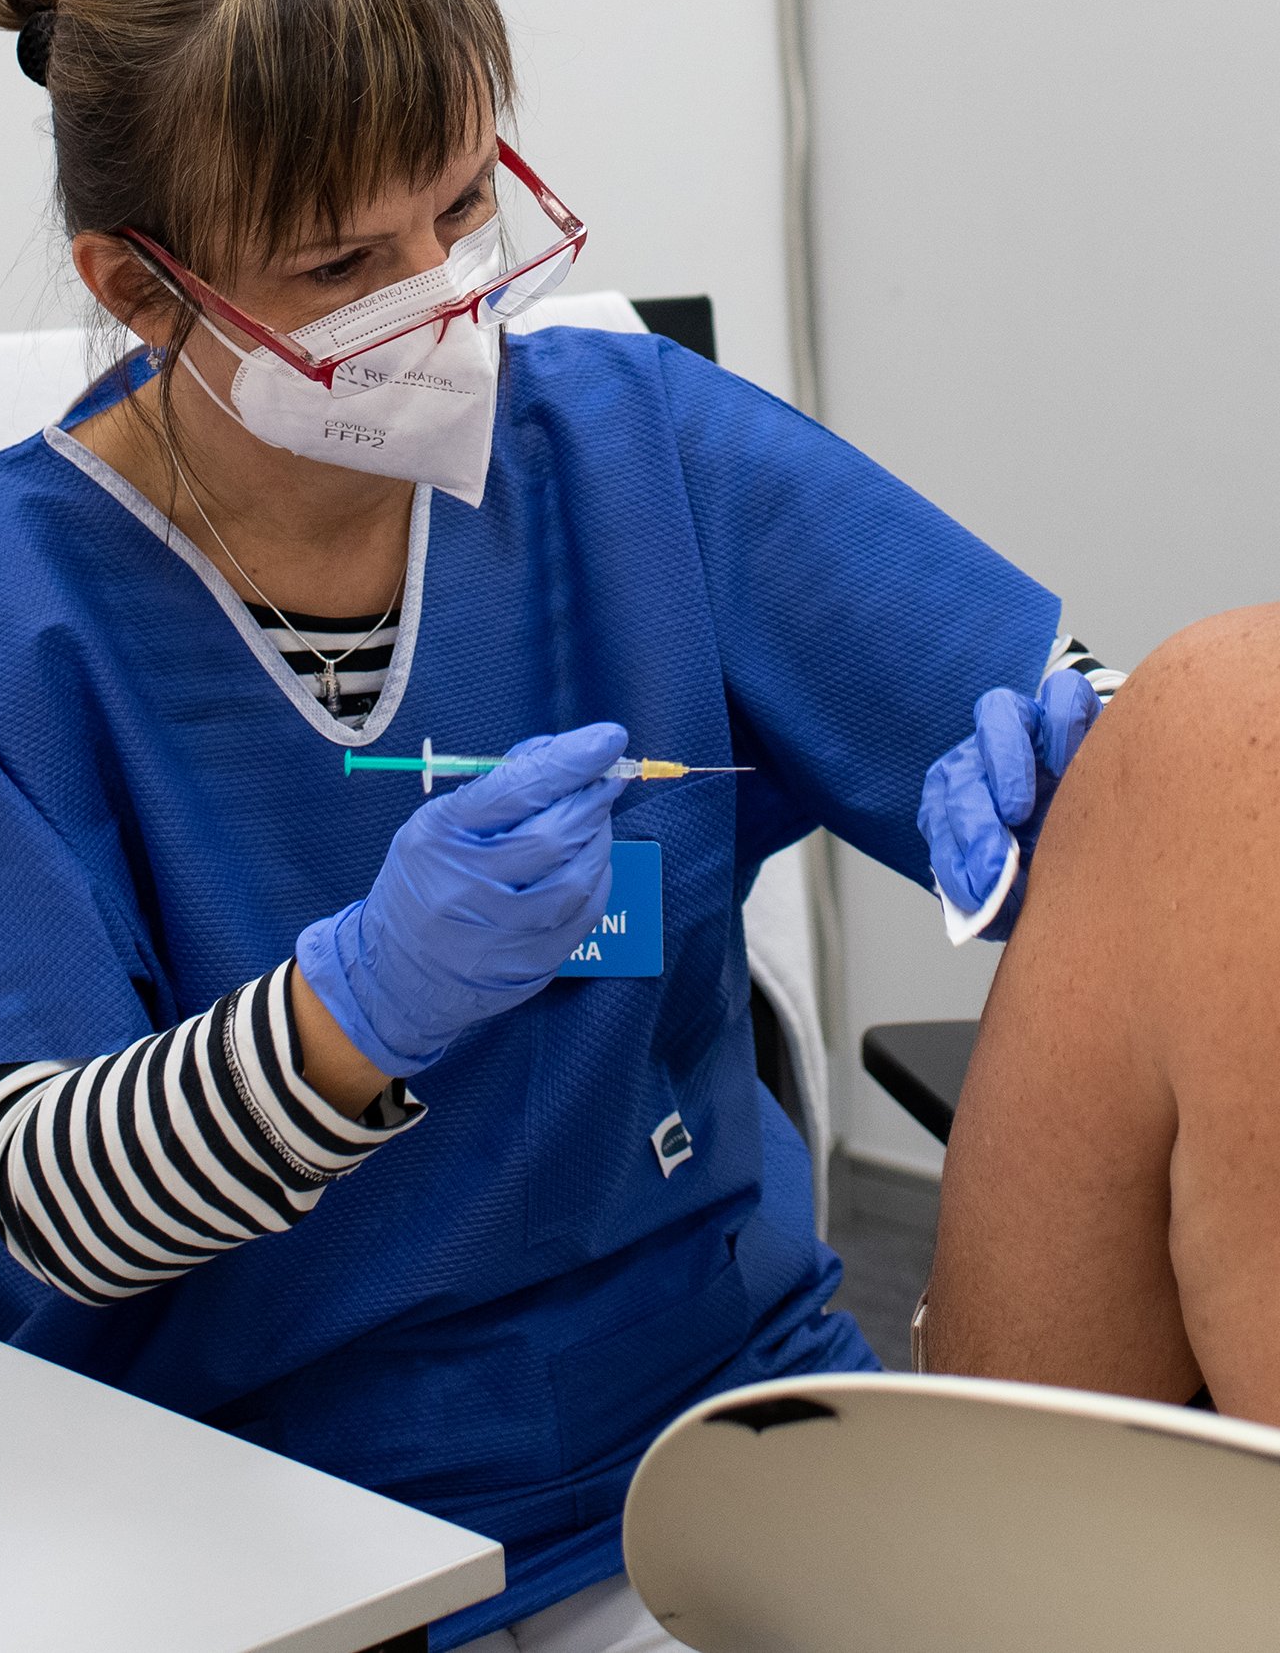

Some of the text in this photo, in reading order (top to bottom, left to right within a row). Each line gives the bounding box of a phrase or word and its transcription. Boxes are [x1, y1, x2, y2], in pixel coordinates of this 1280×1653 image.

[349, 286, 402, 314] MADE IN EU
[324, 419, 386, 437] COVID-19
[324, 427, 385, 450] FFP2
